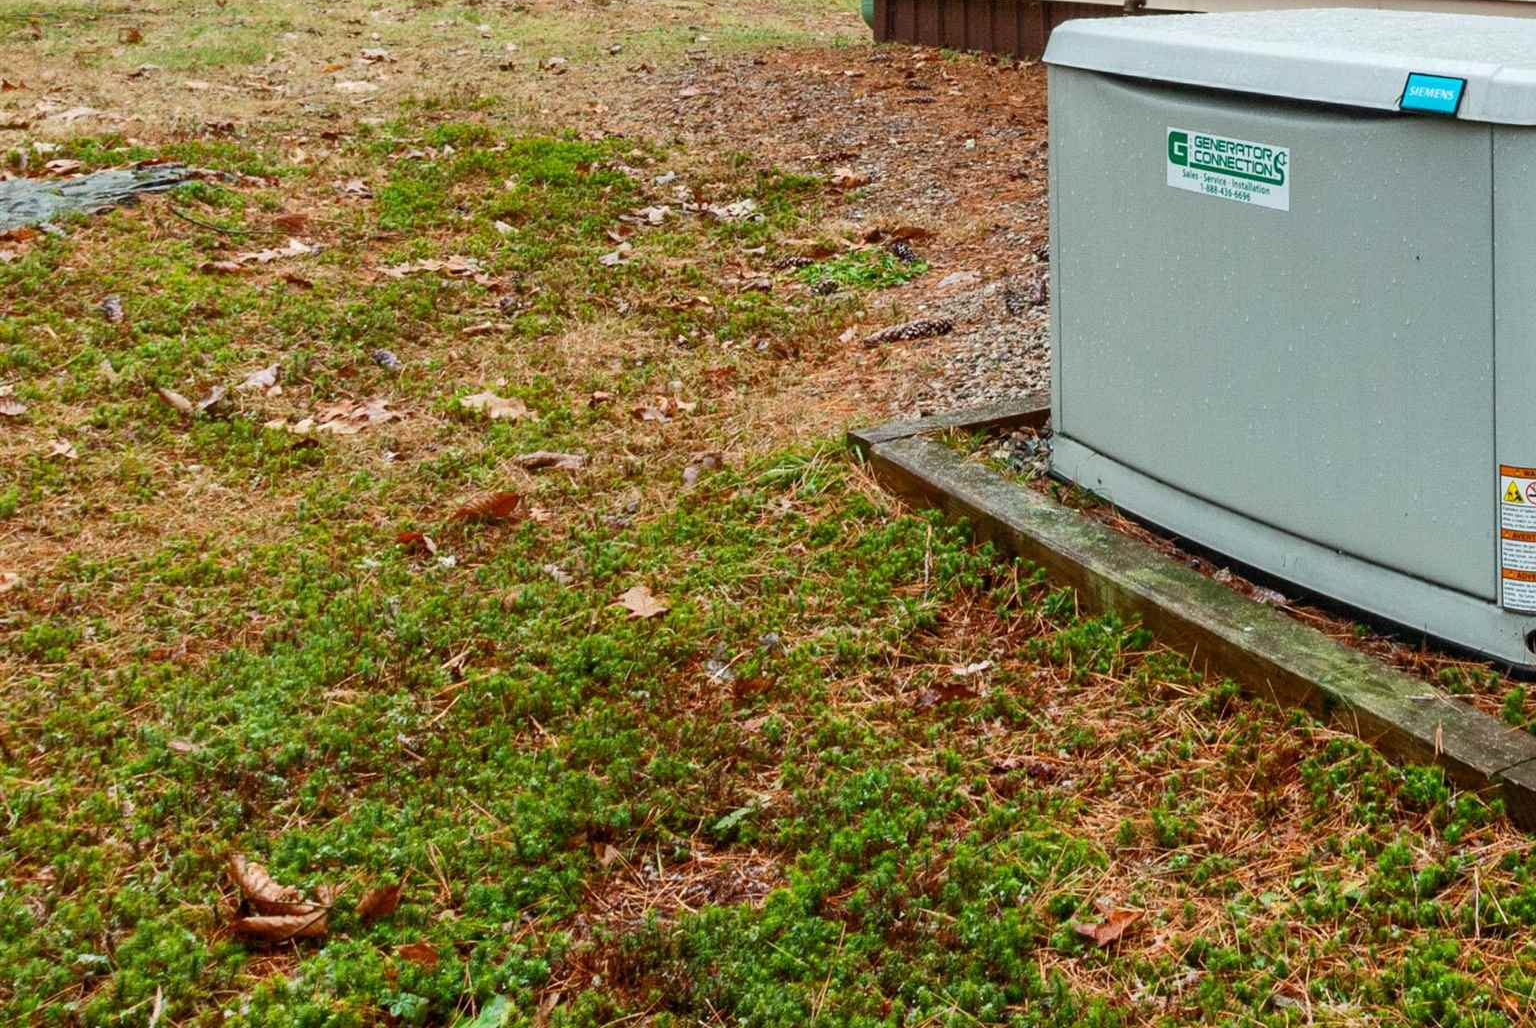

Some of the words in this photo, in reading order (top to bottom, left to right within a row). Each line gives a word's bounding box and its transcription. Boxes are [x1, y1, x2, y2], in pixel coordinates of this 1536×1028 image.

[1409, 85, 1455, 100] SIEMENS
[1194, 135, 1273, 161] GENERATOR
[1194, 150, 1273, 176] CONNECTION
[1182, 168, 1199, 180] Sales
[1203, 172, 1227, 186] Service
[1231, 178, 1271, 195] Installation
